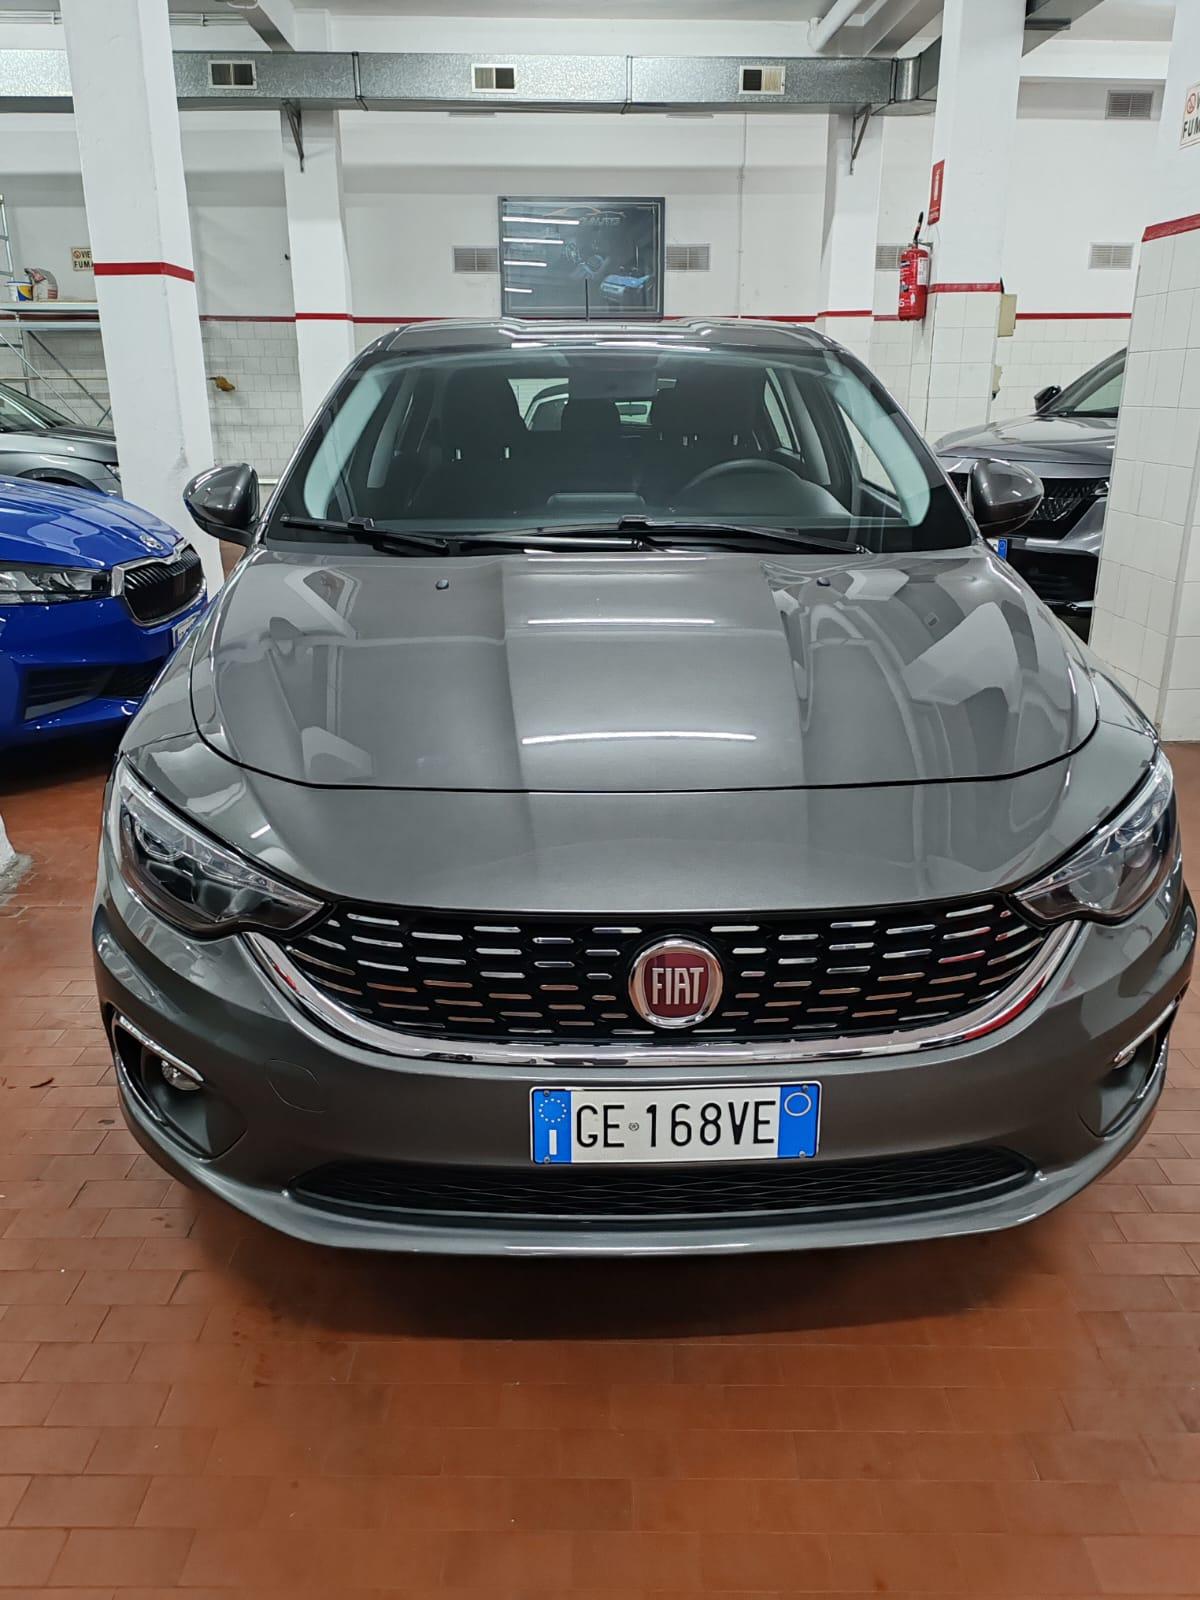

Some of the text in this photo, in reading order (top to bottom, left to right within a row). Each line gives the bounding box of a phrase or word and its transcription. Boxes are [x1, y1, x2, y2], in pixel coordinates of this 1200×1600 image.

[651, 967, 705, 1005] FIAT
[576, 1100, 777, 1148] GE 168VE
